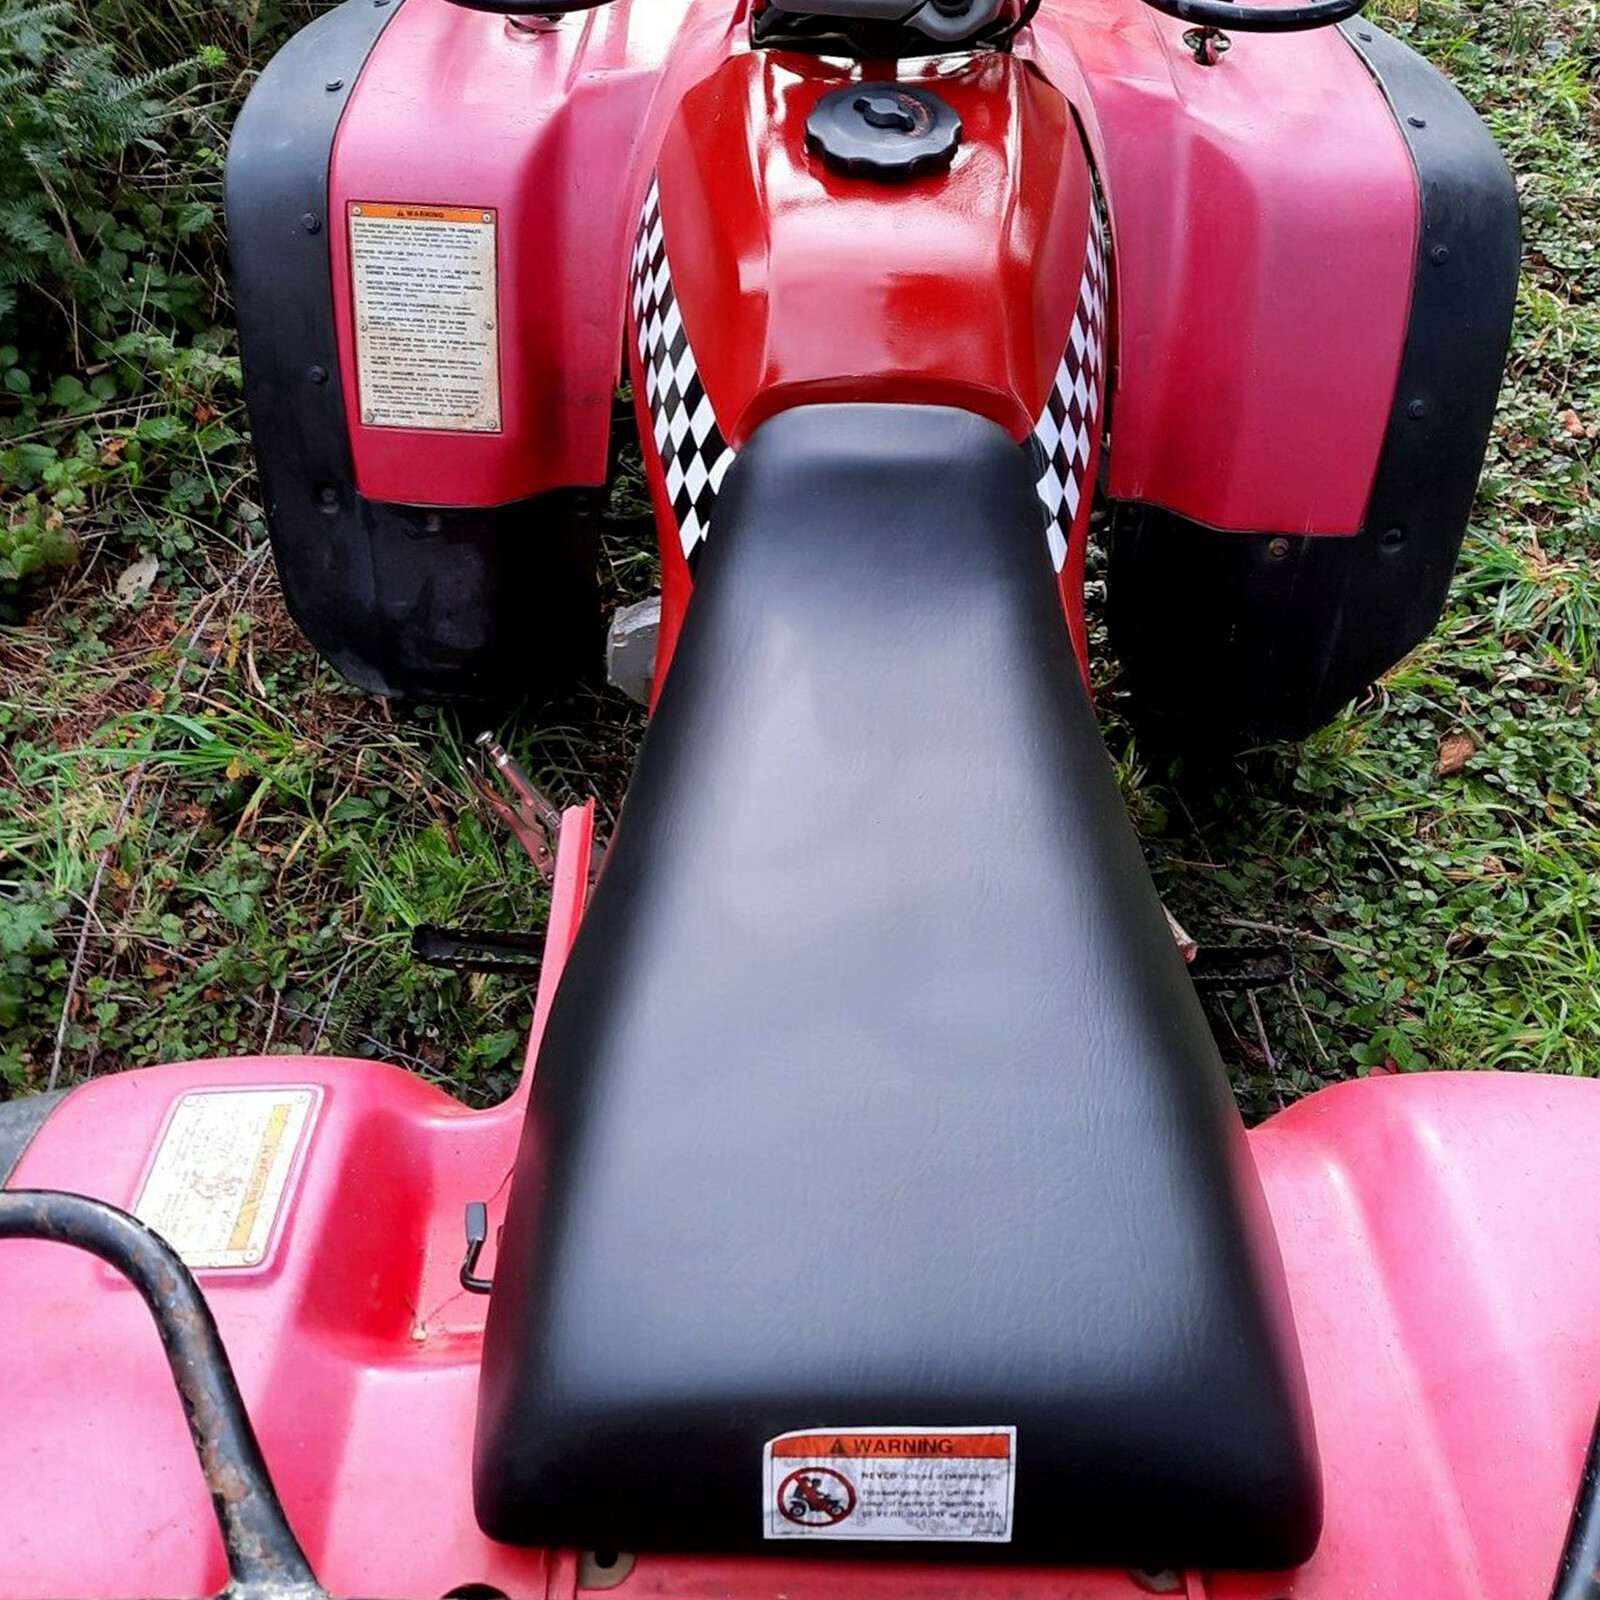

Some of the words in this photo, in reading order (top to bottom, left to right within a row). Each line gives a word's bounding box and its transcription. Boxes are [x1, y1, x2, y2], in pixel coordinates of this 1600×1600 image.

[406, 210, 445, 218] WARNING
[855, 1438, 954, 1454] WARNING
[861, 1472, 897, 1480] NEVER
